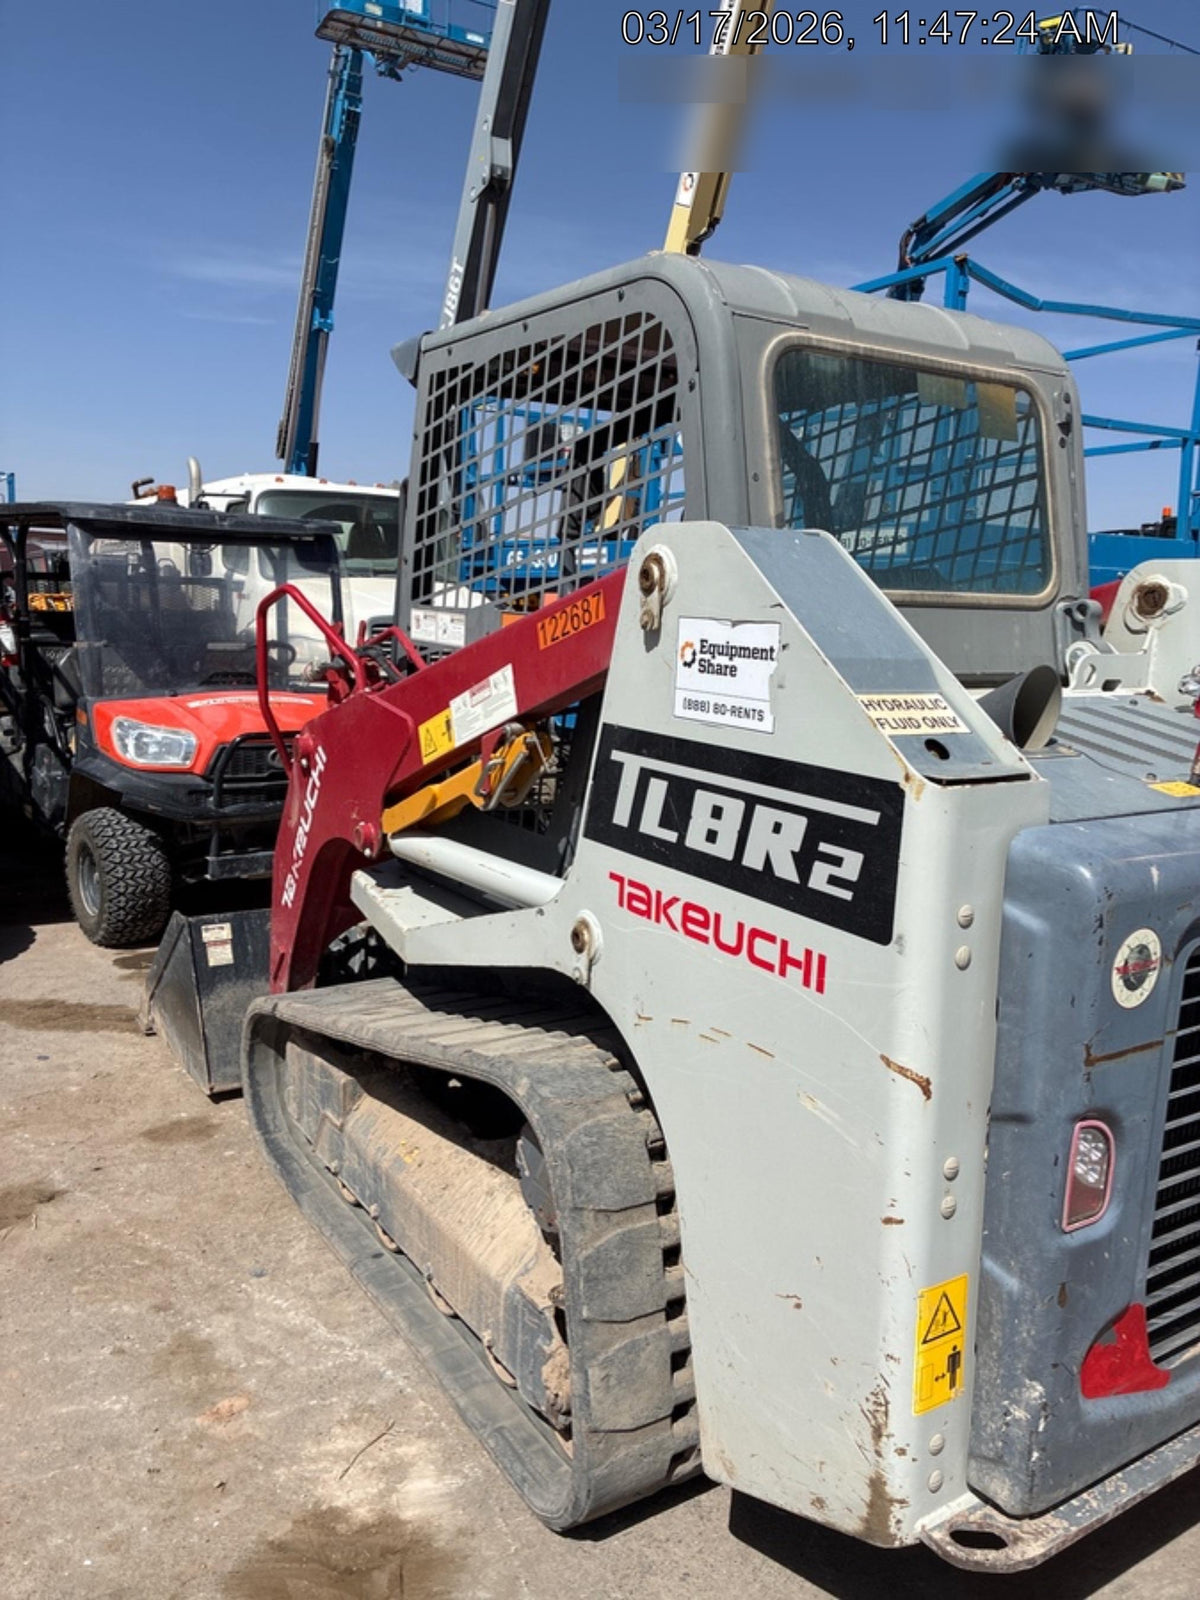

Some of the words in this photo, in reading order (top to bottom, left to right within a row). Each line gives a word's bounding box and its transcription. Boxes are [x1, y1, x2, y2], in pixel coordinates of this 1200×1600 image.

[540, 592, 601, 645] 122687
[700, 639, 775, 662] Equipment
[698, 658, 738, 678] Share
[682, 697, 710, 714] (888)
[713, 702, 765, 722] 80-RENTS
[860, 698, 948, 711] HYDRAULIC
[875, 718, 921, 730] FLUID
[922, 716, 961, 728] ONLY
